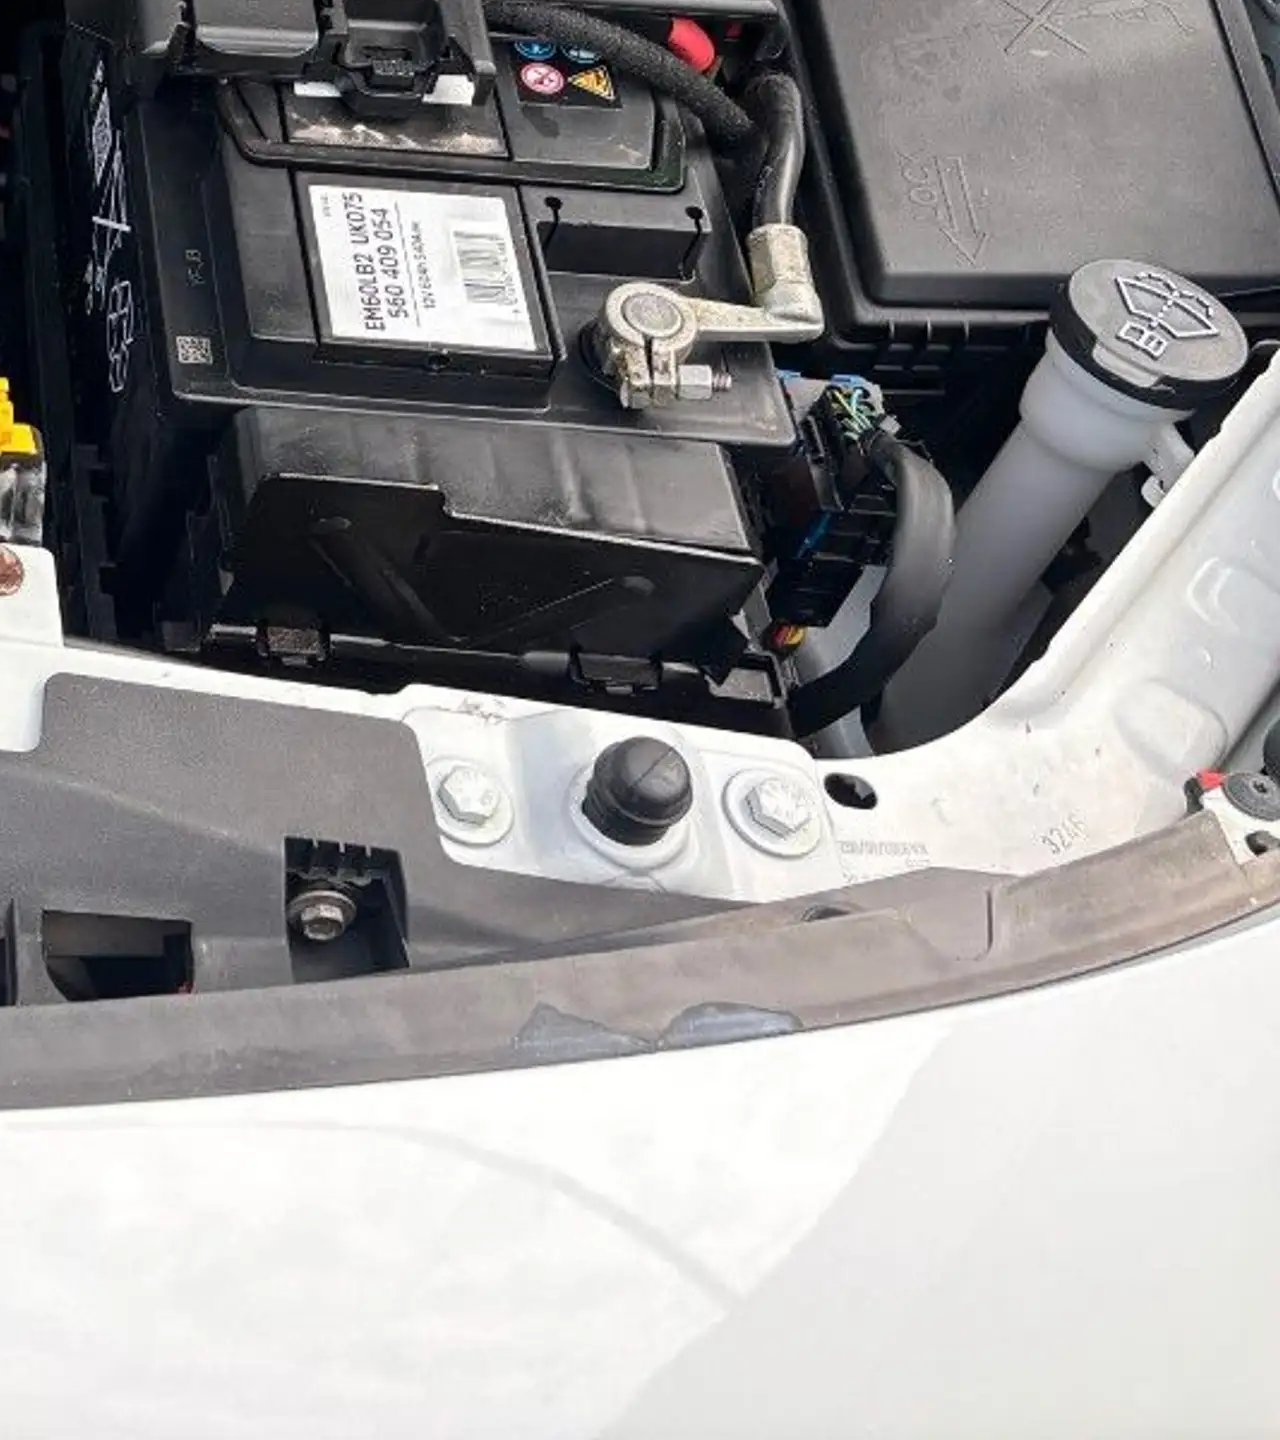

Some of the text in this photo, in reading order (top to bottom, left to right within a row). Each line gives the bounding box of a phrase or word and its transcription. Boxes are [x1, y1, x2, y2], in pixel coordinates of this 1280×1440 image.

[342, 192, 387, 333] EM60LB2 UK075
[370, 207, 409, 320] 560 409 054
